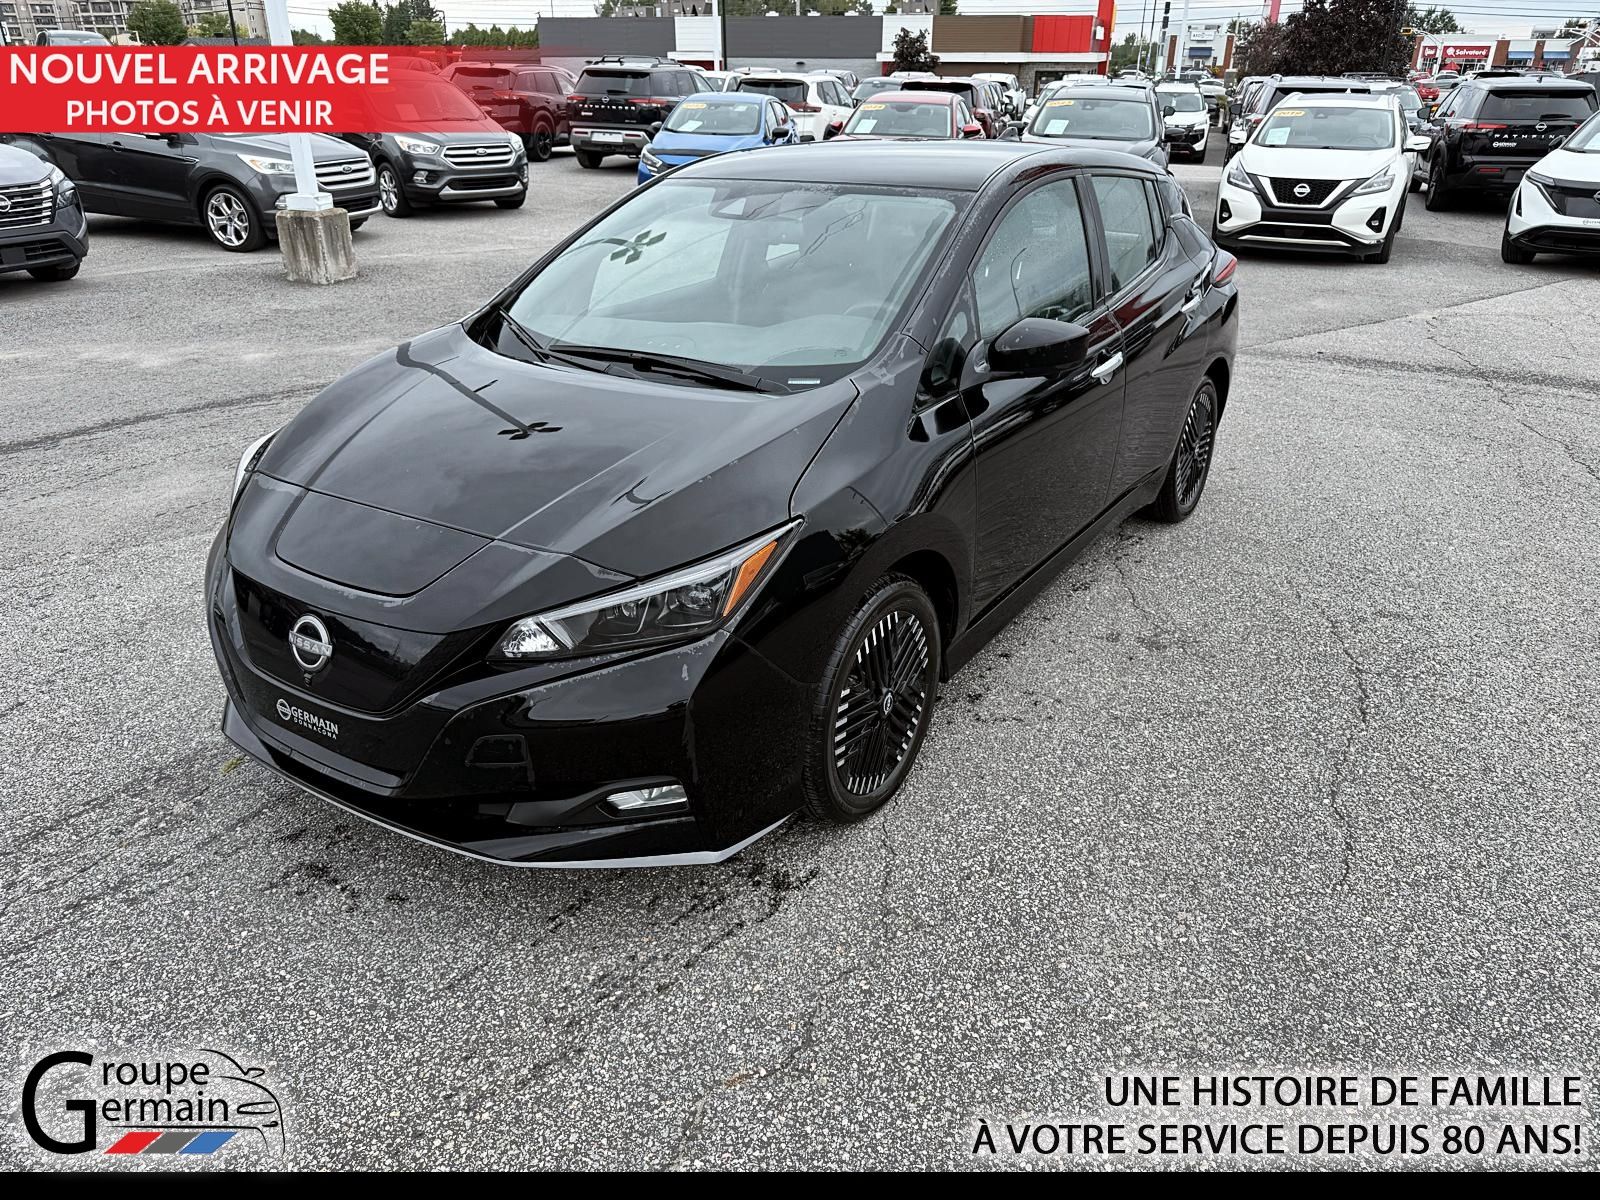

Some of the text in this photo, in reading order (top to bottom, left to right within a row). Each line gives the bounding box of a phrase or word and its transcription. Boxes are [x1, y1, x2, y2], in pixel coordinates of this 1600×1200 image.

[289, 630, 333, 657] NISSAN
[290, 706, 339, 735] GERMAIN
[293, 717, 337, 740] DONNACONA
